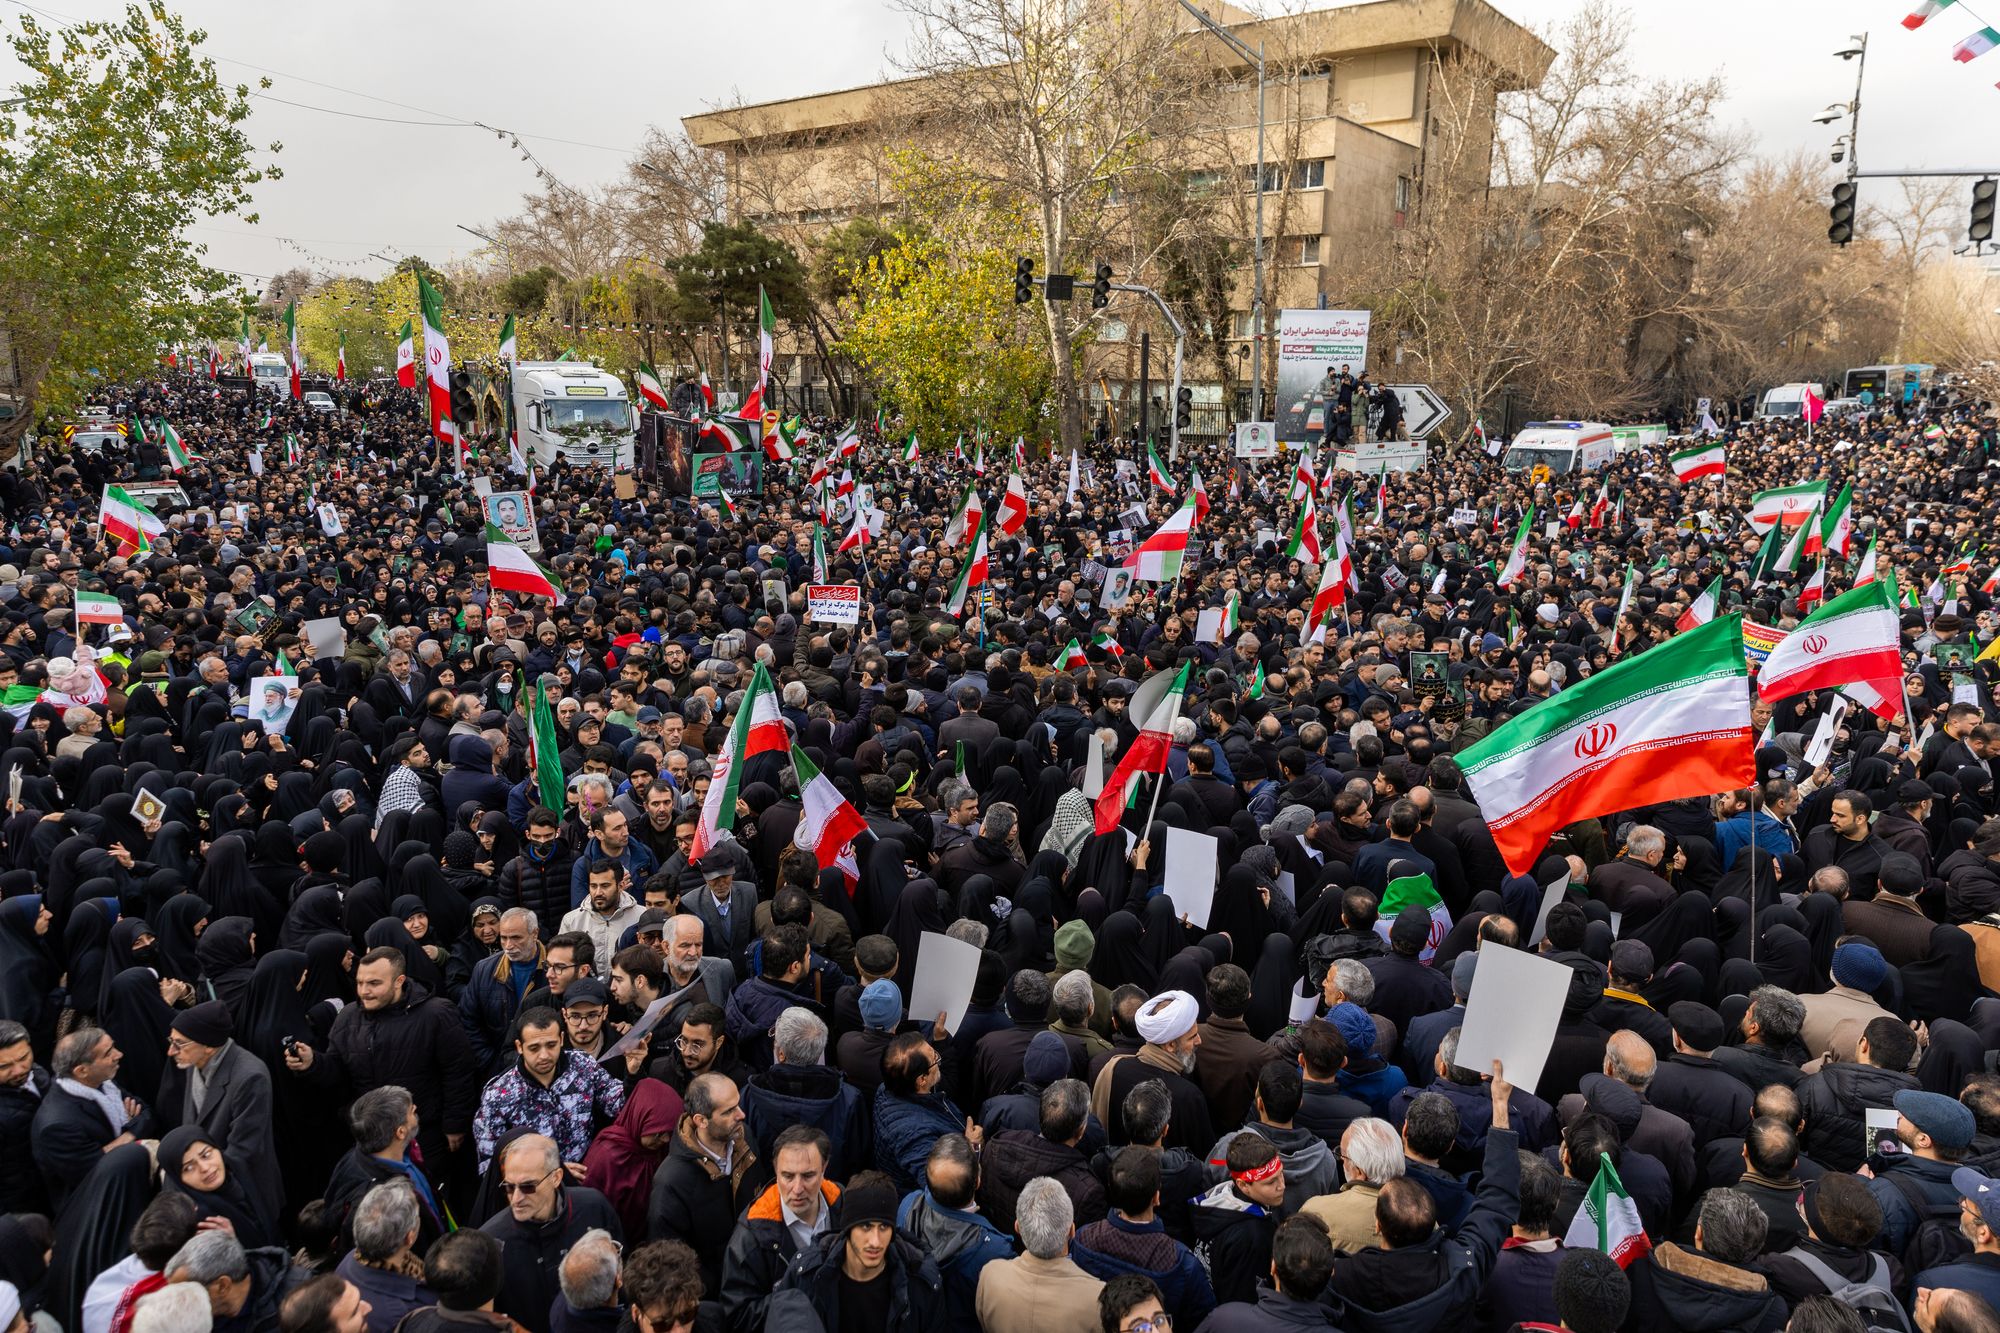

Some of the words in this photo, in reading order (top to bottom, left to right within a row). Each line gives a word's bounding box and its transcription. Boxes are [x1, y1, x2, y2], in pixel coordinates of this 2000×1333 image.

[1283, 326, 1301, 336] ایران
[1301, 327, 1314, 336] ملی
[1314, 326, 1341, 337] مقاومت
[1342, 327, 1366, 337] شهدای
[810, 600, 827, 608] آمریکا
[834, 601, 845, 609] مرگ
